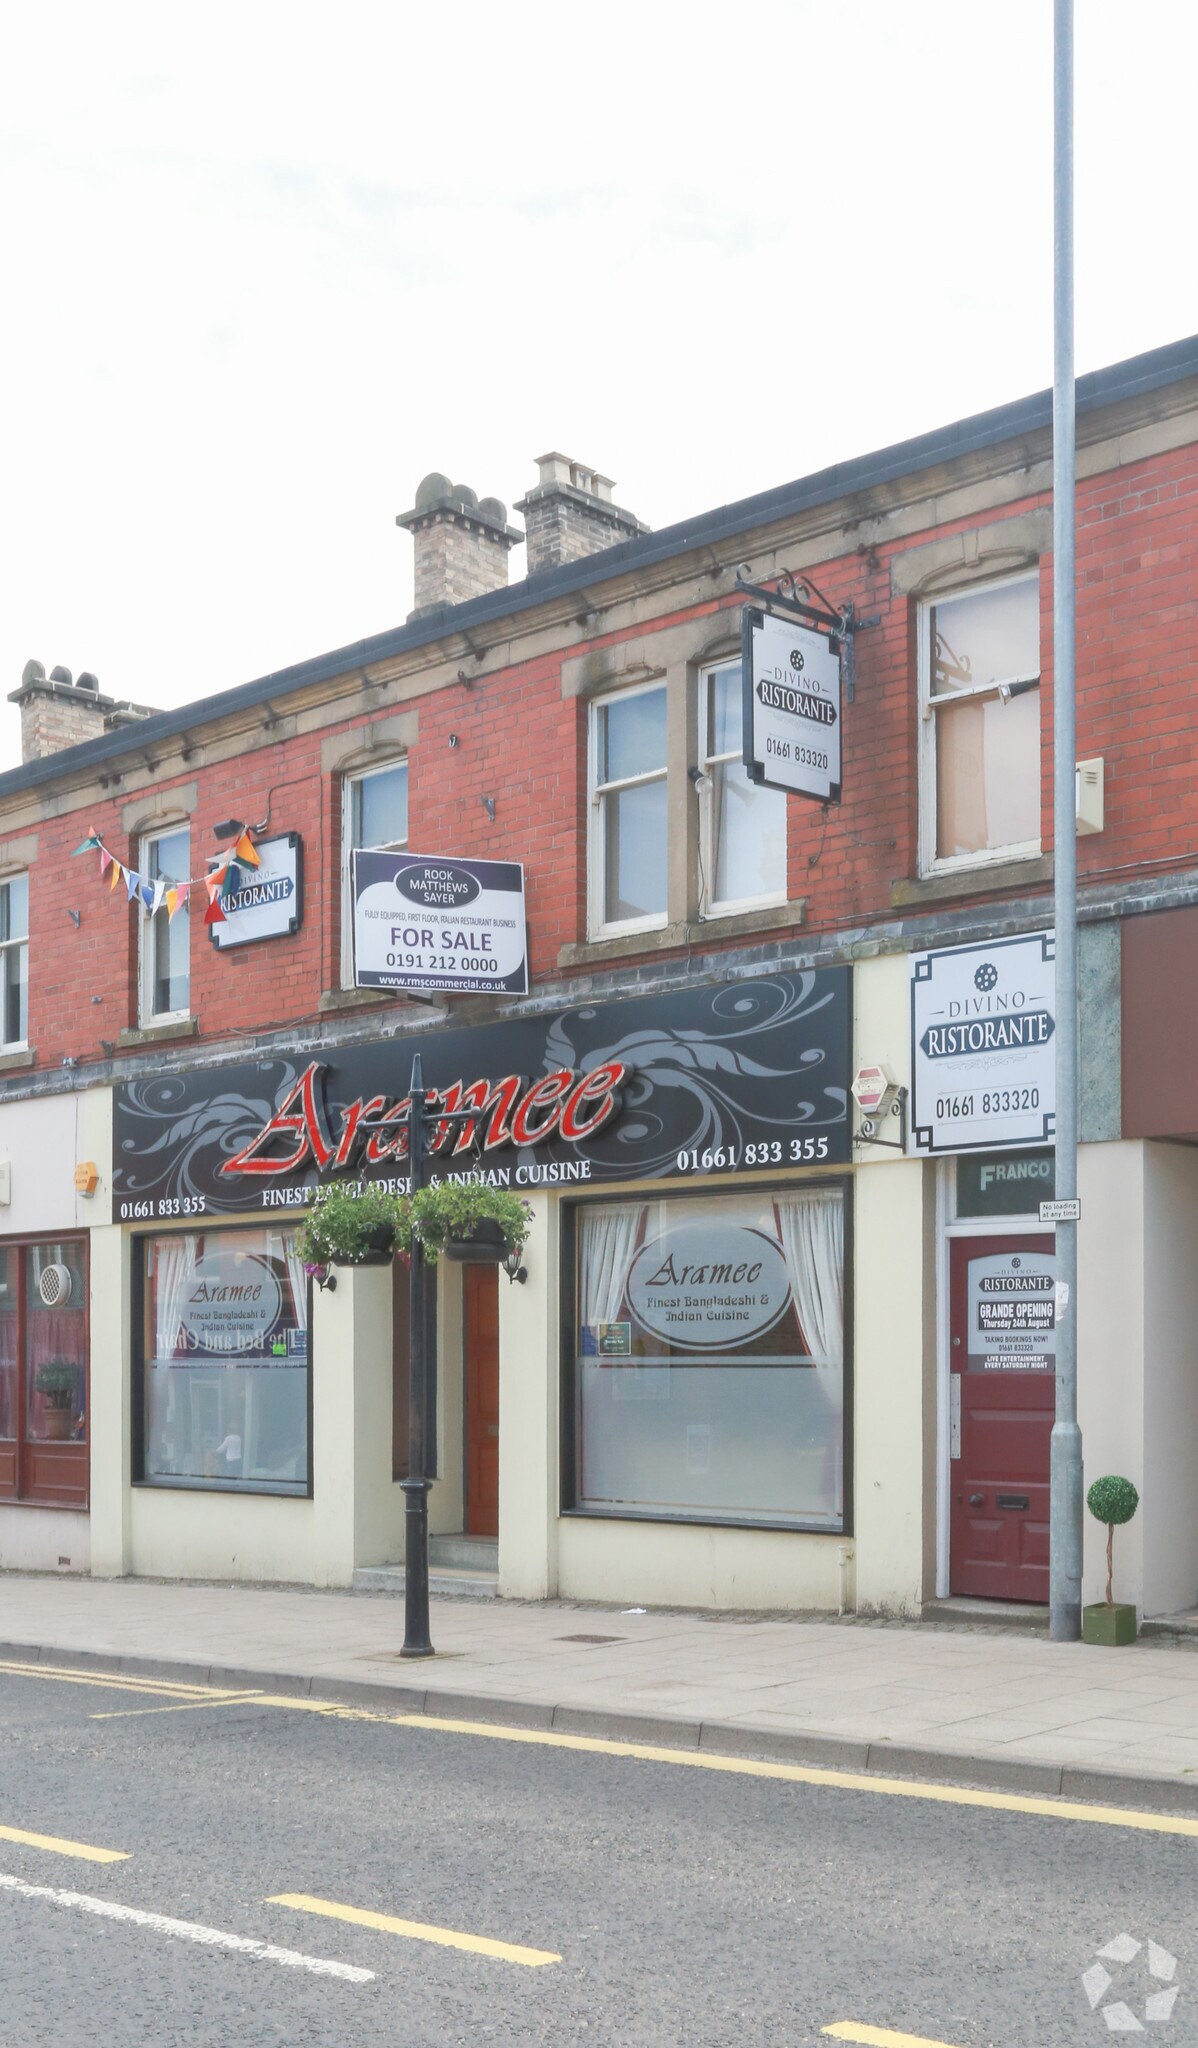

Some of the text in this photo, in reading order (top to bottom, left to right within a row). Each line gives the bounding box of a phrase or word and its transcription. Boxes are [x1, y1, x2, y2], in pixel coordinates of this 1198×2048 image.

[774, 667, 820, 693] DIVINO
[761, 681, 833, 724] RISTORANTE
[766, 737, 828, 769] 01661 833320
[410, 879, 468, 893] MATTHEWS
[424, 869, 453, 881] ROOK
[424, 892, 455, 904] SAYER
[365, 910, 516, 928] FULLY EQUIPPED, FIRST FLOOR, ITALIAN RESTAURANT BUSINESS
[390, 927, 492, 952] FOR SALE
[386, 952, 498, 972] 0191 212 0000
[379, 975, 506, 991] www.rmscommercial.co.uk
[949, 991, 1025, 1018] DIVINO
[928, 1014, 1048, 1056] RISTORANTE
[936, 1088, 1039, 1118] 01661 833320
[218, 1060, 631, 1176] Aramee
[676, 1136, 829, 1170] 01661 833 355
[262, 1186, 312, 1206] FINEST
[430, 1174, 440, 1191] &
[447, 1168, 511, 1188] INDIAN
[515, 1160, 592, 1184] CUISINE
[980, 1161, 1050, 1191] FRANCO
[120, 1195, 206, 1218] 01661 833 355
[1054, 1203, 1076, 1211] loading
[645, 1253, 762, 1286] Aramee
[188, 1280, 262, 1303] Aramee
[984, 1277, 1049, 1291] RISTORANTE
[647, 1294, 769, 1309] Finest Bangladeshi &
[980, 1303, 1053, 1318] GRANDE OPENING
[666, 1310, 750, 1322] Indian Cuisine
[983, 1318, 1050, 1329] Thursday 24th August
